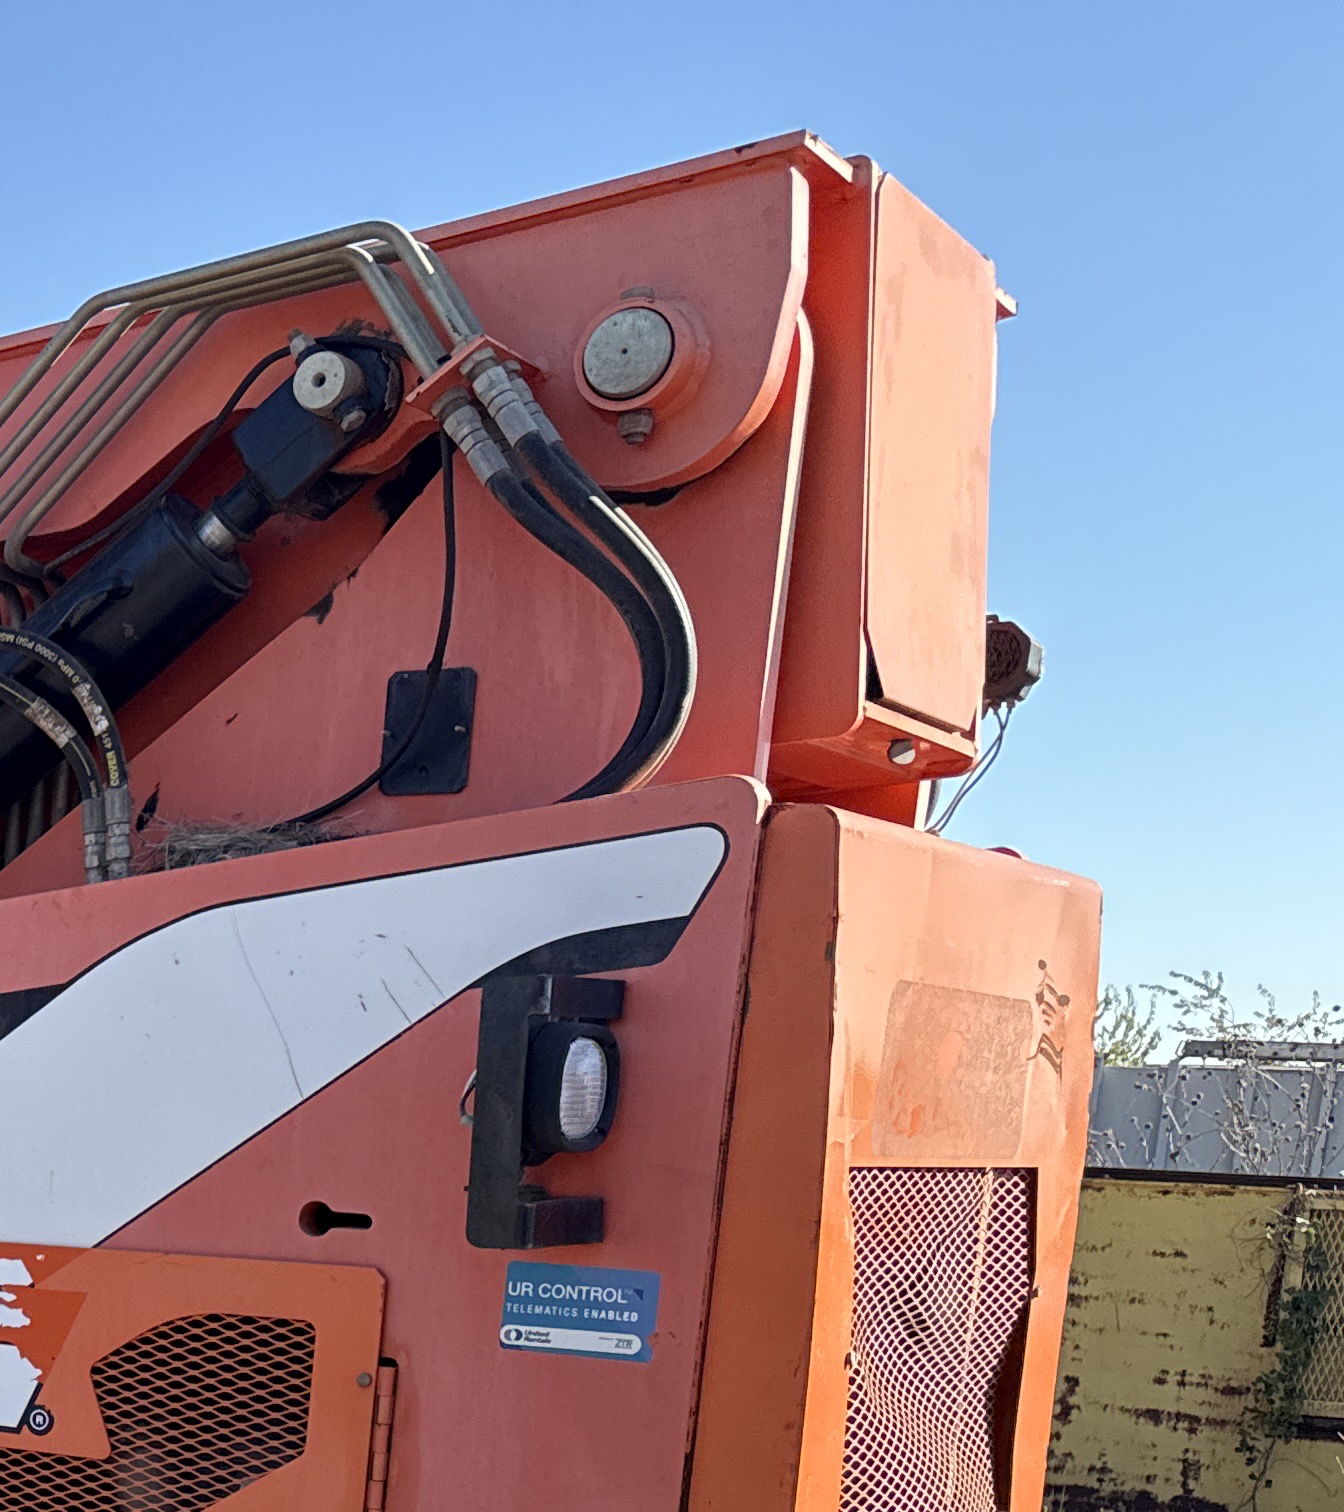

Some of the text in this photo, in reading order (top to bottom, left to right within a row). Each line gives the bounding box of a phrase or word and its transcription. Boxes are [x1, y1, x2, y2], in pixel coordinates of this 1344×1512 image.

[15, 635, 34, 648] PSI)
[34, 644, 57, 661] (3000
[56, 659, 74, 676] MPa
[106, 750, 119, 787] COVER
[507, 1281, 534, 1297] UR
[506, 1303, 639, 1322] TELEMATICS ENABLED
